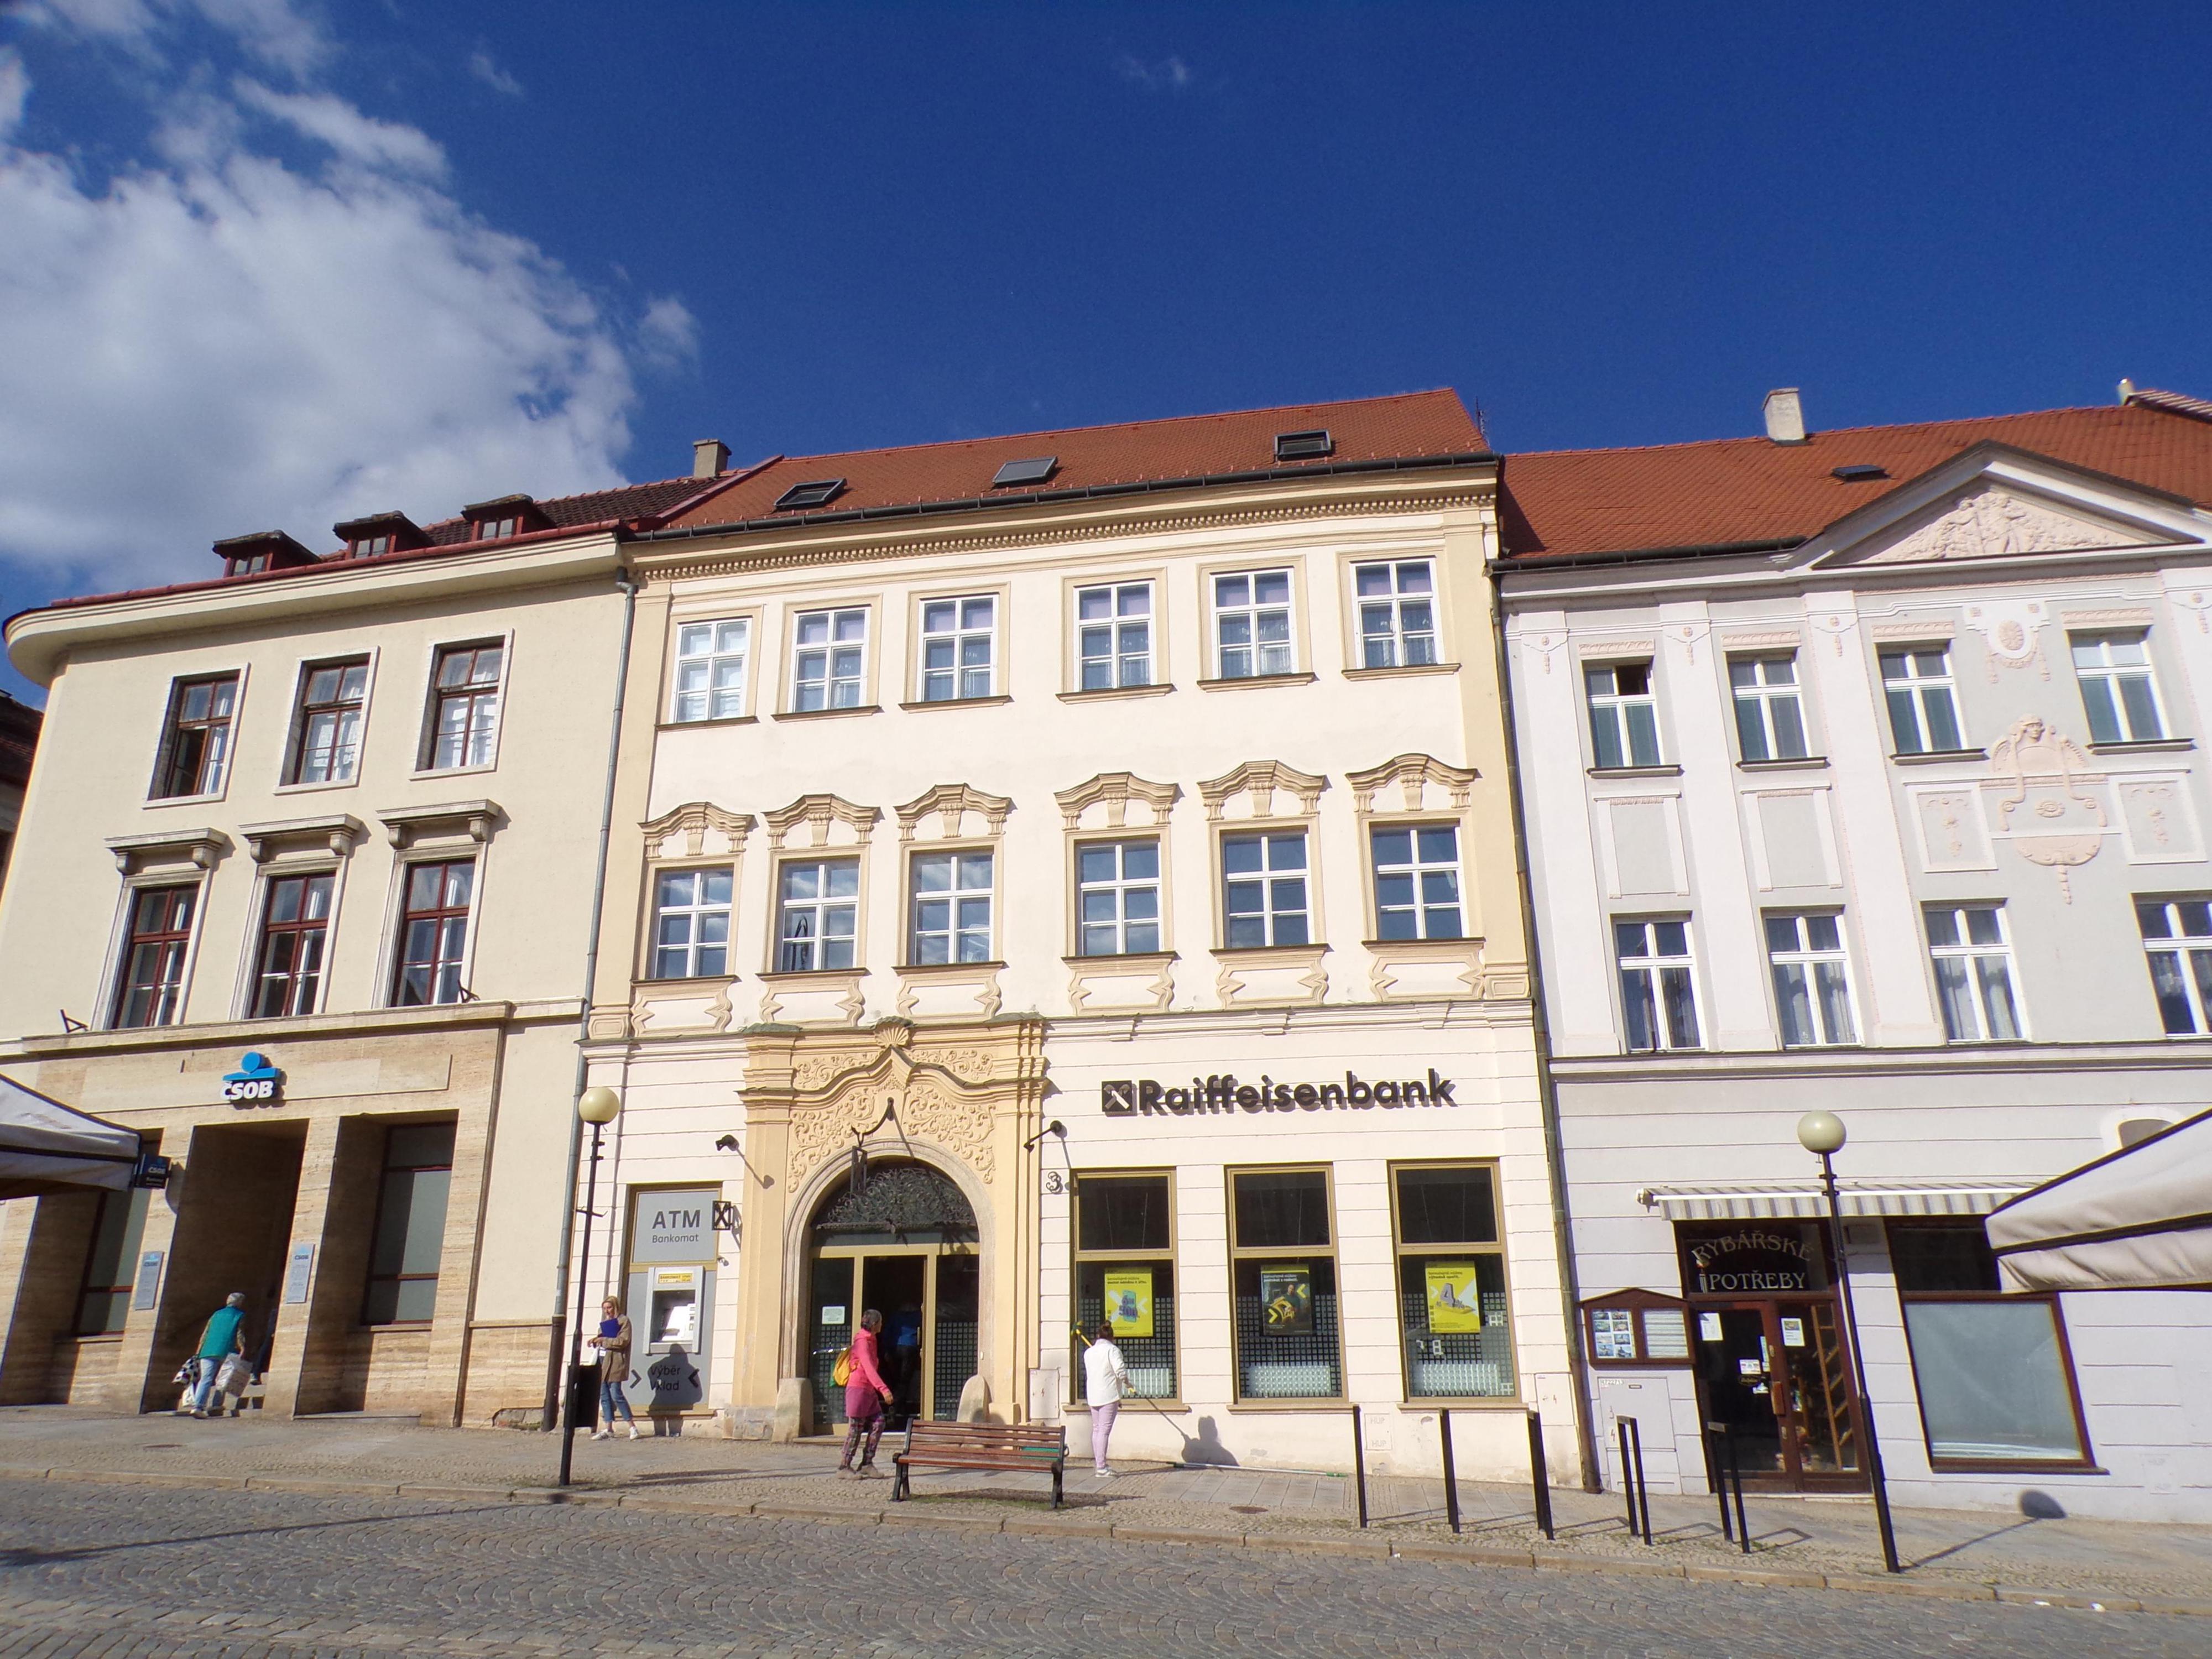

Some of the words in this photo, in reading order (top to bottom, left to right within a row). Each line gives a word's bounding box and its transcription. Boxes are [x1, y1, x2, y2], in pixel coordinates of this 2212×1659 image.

[221, 1081, 274, 1100] ČSOB
[1139, 1068, 1454, 1111] Raiffeisenbank
[1046, 1171, 1060, 1192] 3
[652, 1209, 701, 1229] ATM
[652, 1234, 699, 1243] Bankomat
[1691, 1230, 1814, 1261] RYBÁŘSKÉ
[1709, 1270, 1805, 1290] POTŘEBY
[650, 1365, 681, 1378] Výběr
[650, 1380, 679, 1390] Vklad
